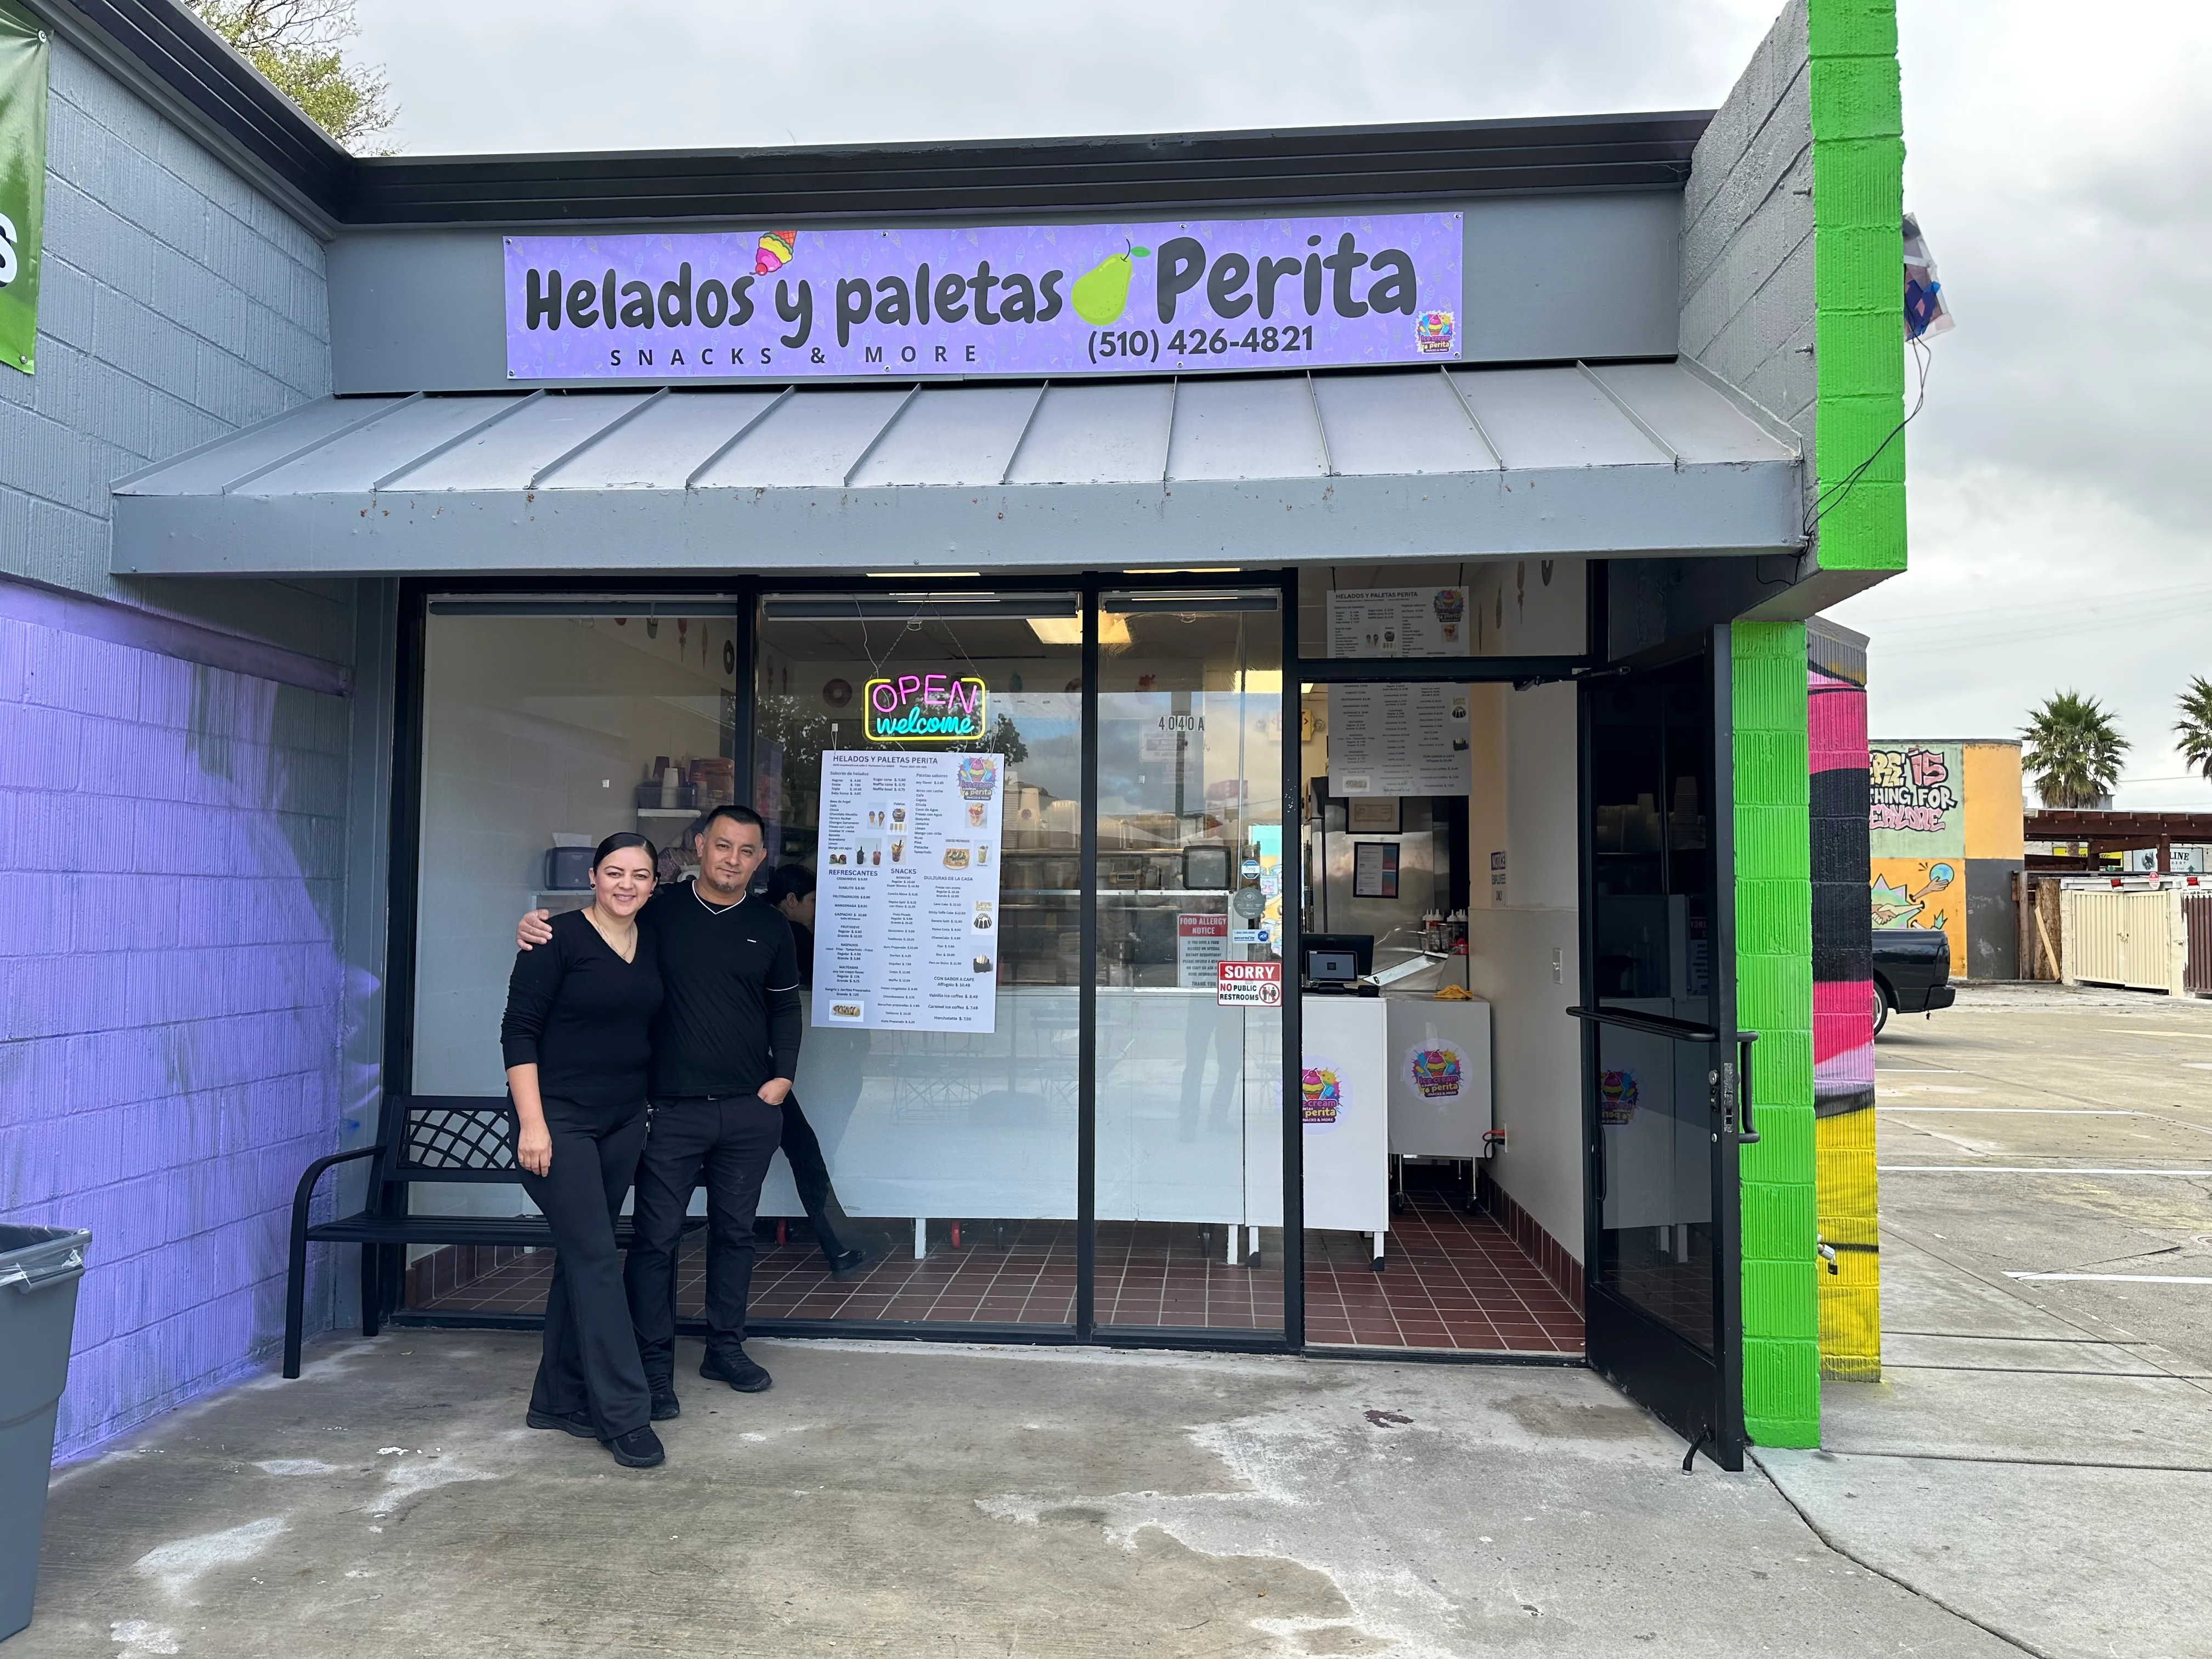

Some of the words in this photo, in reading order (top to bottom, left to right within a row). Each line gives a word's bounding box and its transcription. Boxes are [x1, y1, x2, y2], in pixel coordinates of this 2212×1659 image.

[526, 262, 757, 330] Helados
[775, 279, 813, 348] y
[836, 261, 1064, 347] paletas
[1156, 232, 1417, 324] Perita
[1088, 329, 1158, 364] (510)
[1168, 326, 1314, 355] 426-4821
[610, 347, 771, 366] SNACKS
[810, 347, 826, 363] &
[865, 346, 976, 363] MORE
[873, 675, 977, 713] OPEN
[877, 707, 975, 734] welcome
[970, 788, 992, 796] perita
[1918, 787, 1956, 809] FOR
[1492, 853, 1505, 868] NOTICE
[1199, 917, 1227, 926] ALLERGY
[1192, 927, 1215, 935] NOTICE
[1224, 966, 1274, 979] SORRY
[1220, 983, 1232, 992] NO
[1420, 1076, 1432, 1084] Ice
[1431, 1082, 1459, 1092] perita
[1305, 1107, 1336, 1118] perita
